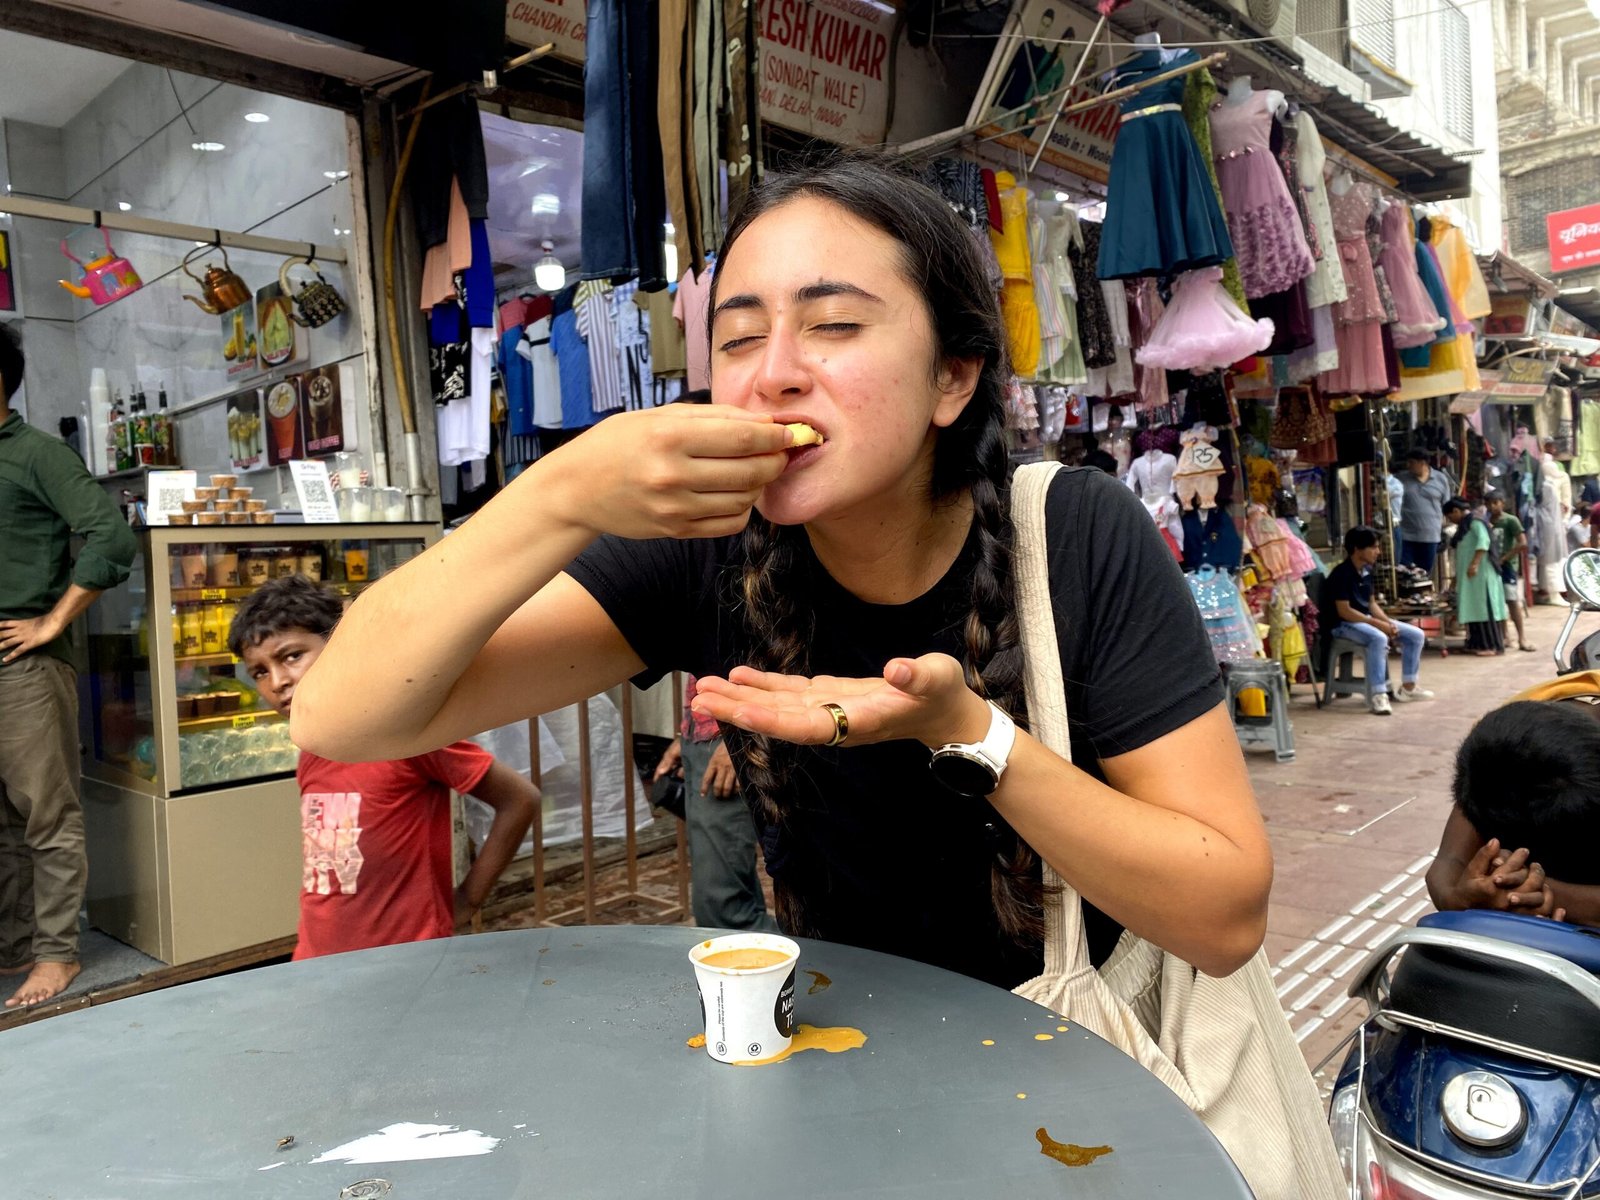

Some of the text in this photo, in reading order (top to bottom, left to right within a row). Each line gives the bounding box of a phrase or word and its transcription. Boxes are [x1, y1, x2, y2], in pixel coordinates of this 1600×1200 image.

[512, 2, 570, 36] CHANDNI
[810, 9, 887, 81] KUMAR
[823, 76, 866, 115] WALE)
